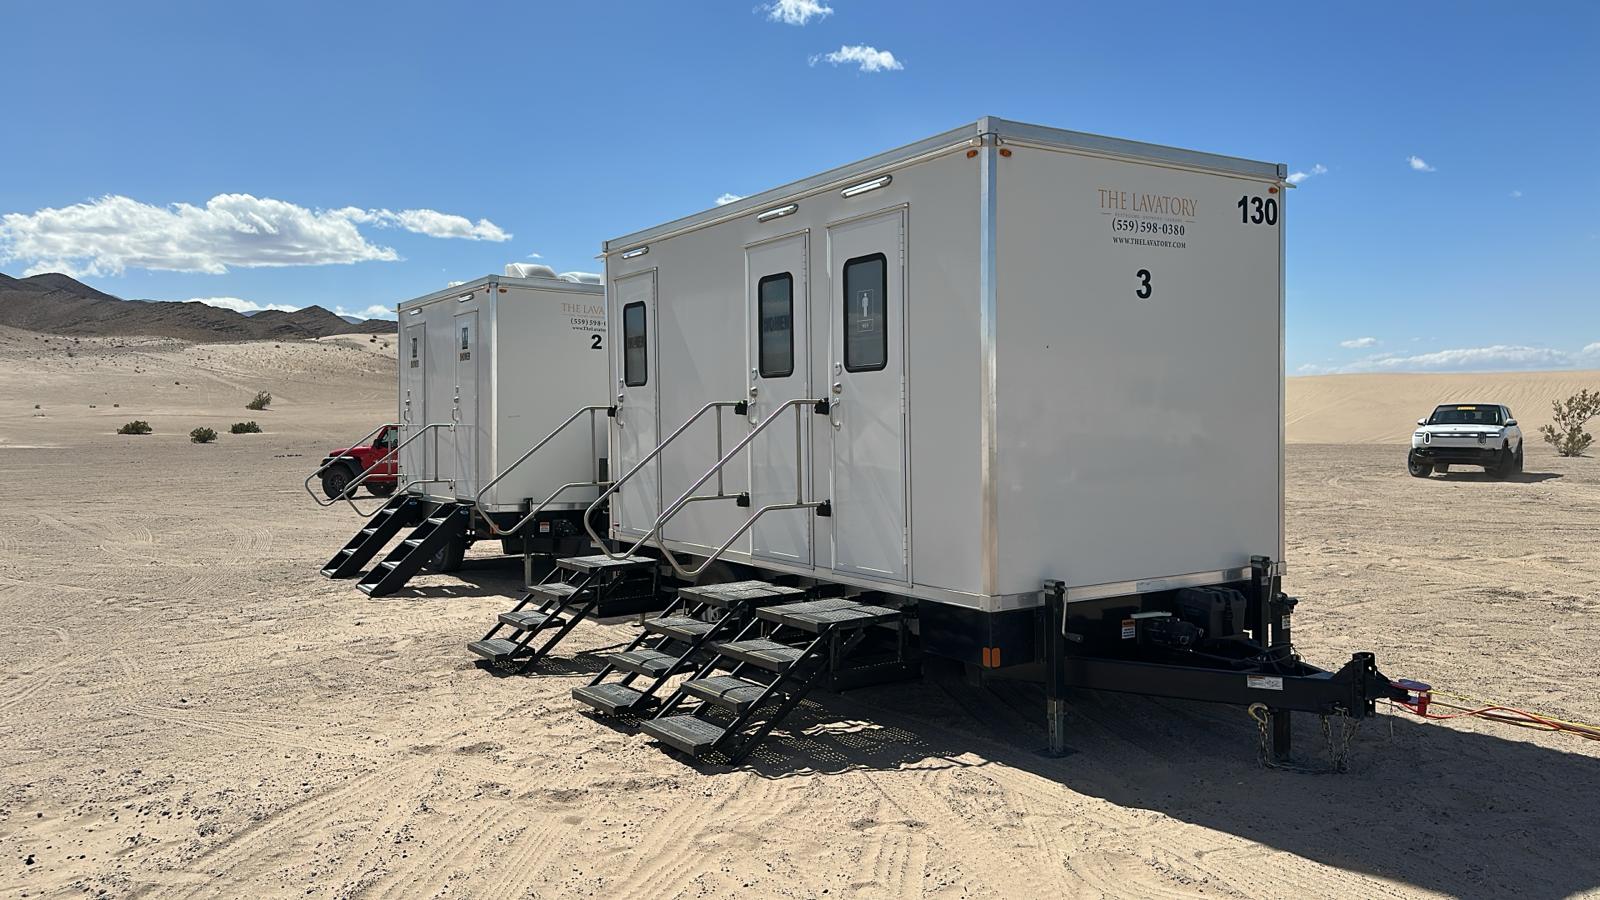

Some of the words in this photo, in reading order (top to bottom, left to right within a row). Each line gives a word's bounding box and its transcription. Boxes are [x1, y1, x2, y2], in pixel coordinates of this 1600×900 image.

[1098, 189, 1127, 210] THE
[1132, 193, 1198, 217] LAVATORY
[1237, 196, 1278, 225] 130
[1112, 236, 1186, 249] WWW.THELAVATORY.COM
[1136, 269, 1152, 299] 3
[560, 303, 581, 313] THE
[591, 334, 602, 350] 2
